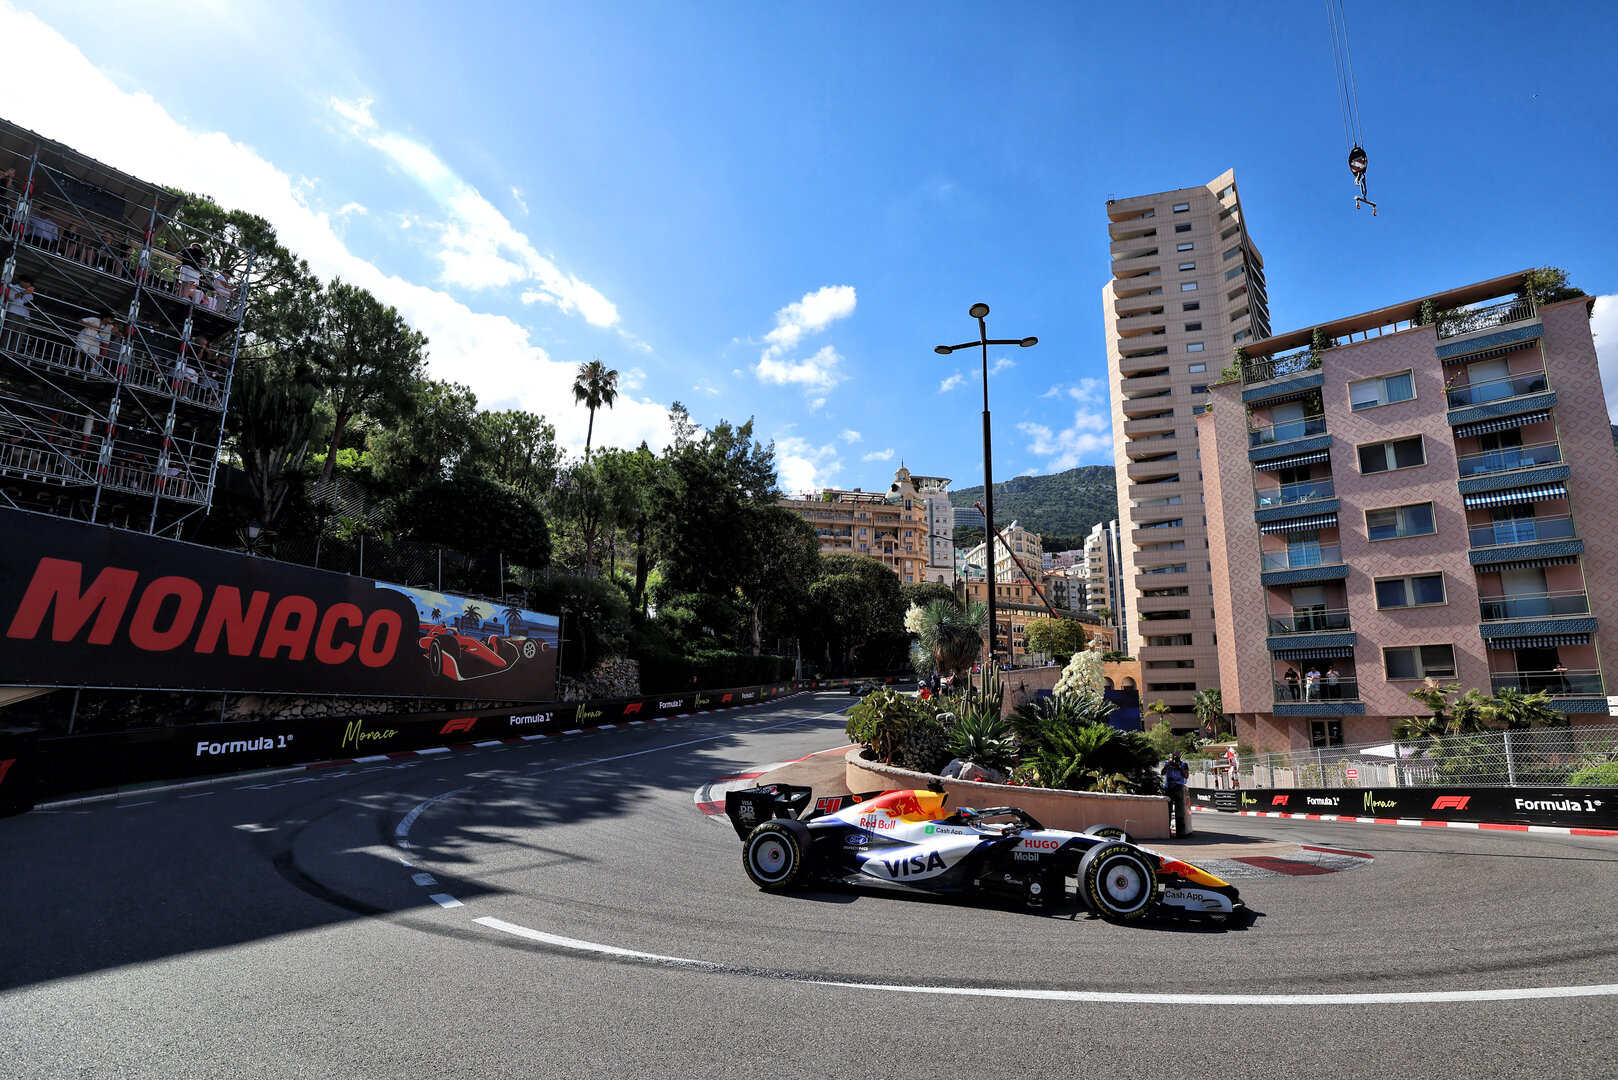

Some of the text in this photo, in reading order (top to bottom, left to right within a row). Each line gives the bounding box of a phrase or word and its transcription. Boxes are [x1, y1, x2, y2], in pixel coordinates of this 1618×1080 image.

[6, 557, 402, 668] MONACO
[659, 701, 678, 709] Formula
[509, 713, 544, 726] Formula
[575, 702, 603, 724] Monaco
[439, 717, 479, 735] F1
[342, 719, 398, 750] Monaco
[196, 737, 274, 757] Formula
[816, 797, 843, 815] 41
[1306, 797, 1332, 806] Formula
[1363, 790, 1397, 814] Monaco
[1431, 795, 1471, 810] F1
[1514, 798, 1582, 812] Formula
[860, 817, 896, 830] Red Bull
[950, 828, 963, 836] App
[1024, 839, 1059, 850] HUGO
[1014, 852, 1039, 862] Mobil
[1099, 847, 1129, 860] ZERO
[883, 850, 948, 878] VISA
[1165, 890, 1204, 901] Cash App
